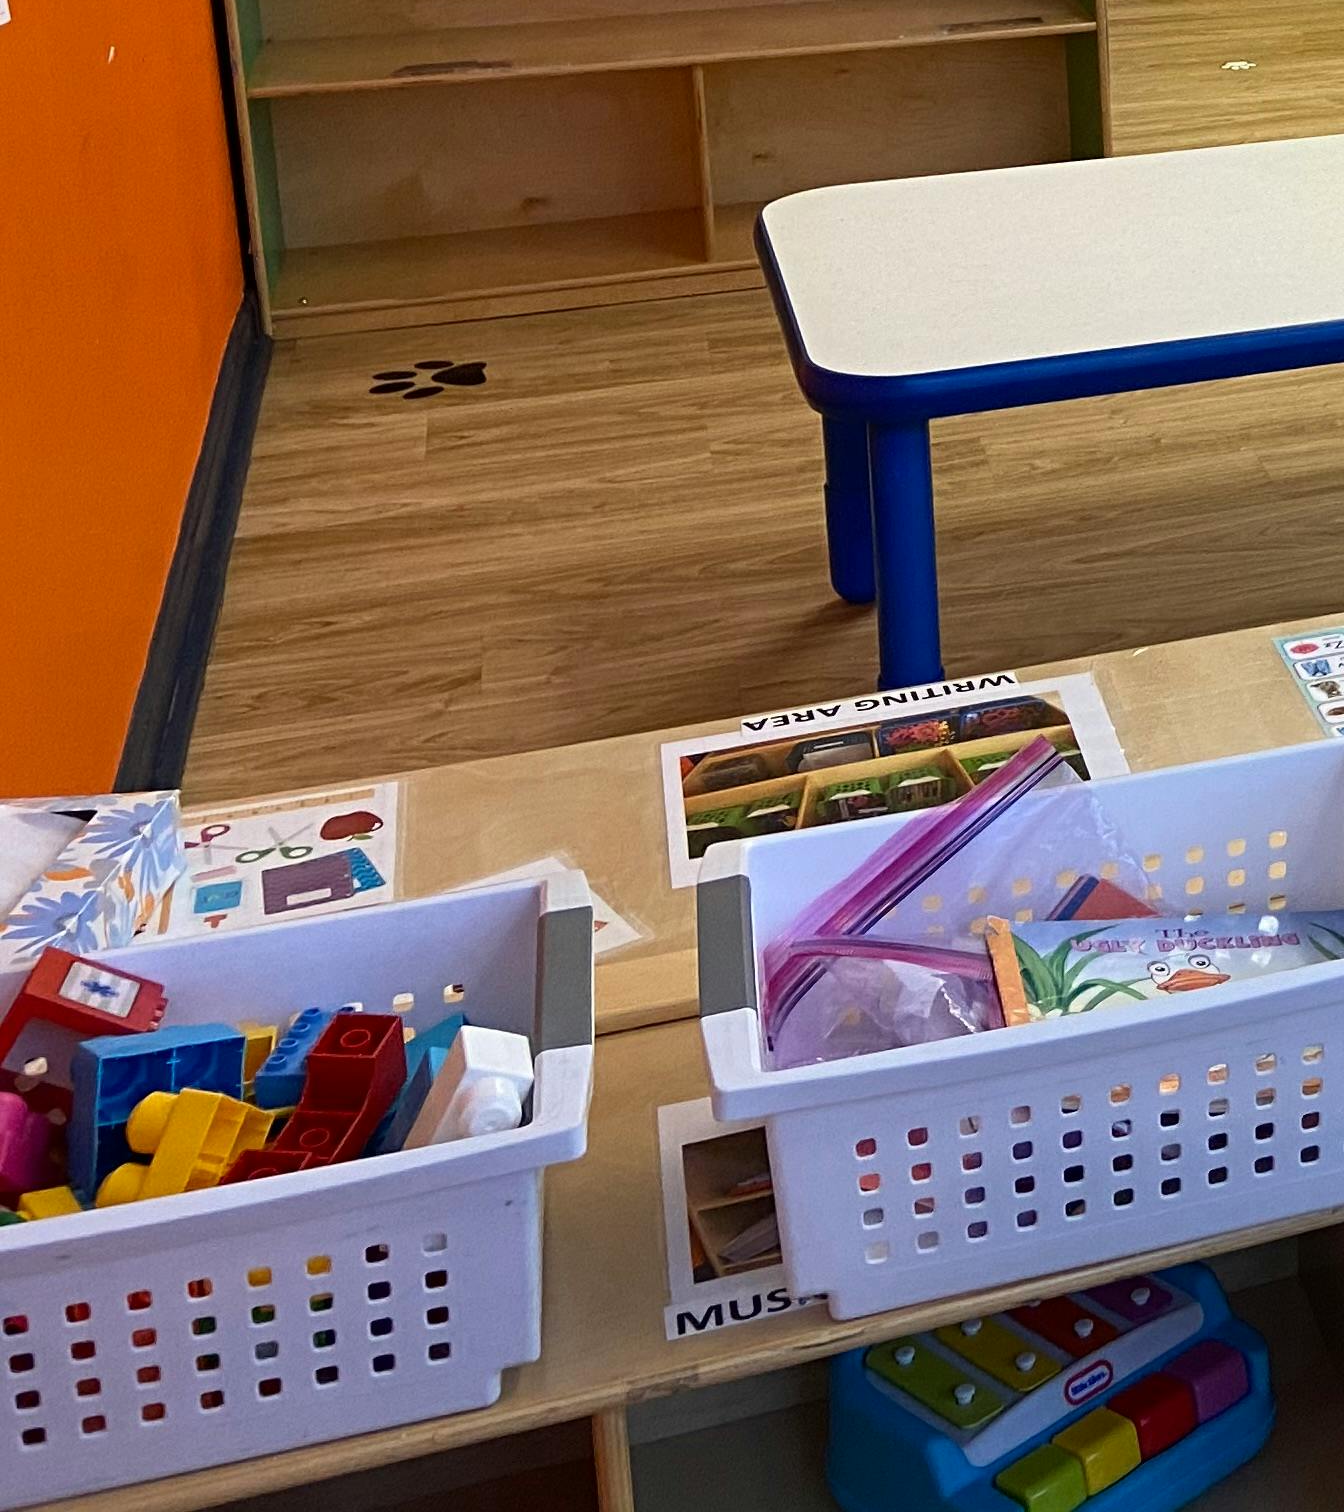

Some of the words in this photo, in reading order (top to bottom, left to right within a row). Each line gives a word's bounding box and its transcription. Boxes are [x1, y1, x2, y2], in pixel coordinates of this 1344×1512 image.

[856, 673, 1017, 712] WRITING
[743, 704, 841, 732] AREA
[1071, 938, 1147, 953] UGLY
[1156, 933, 1301, 953] DUCKLING
[1155, 928, 1209, 938] The
[676, 1287, 828, 1336] MUS
